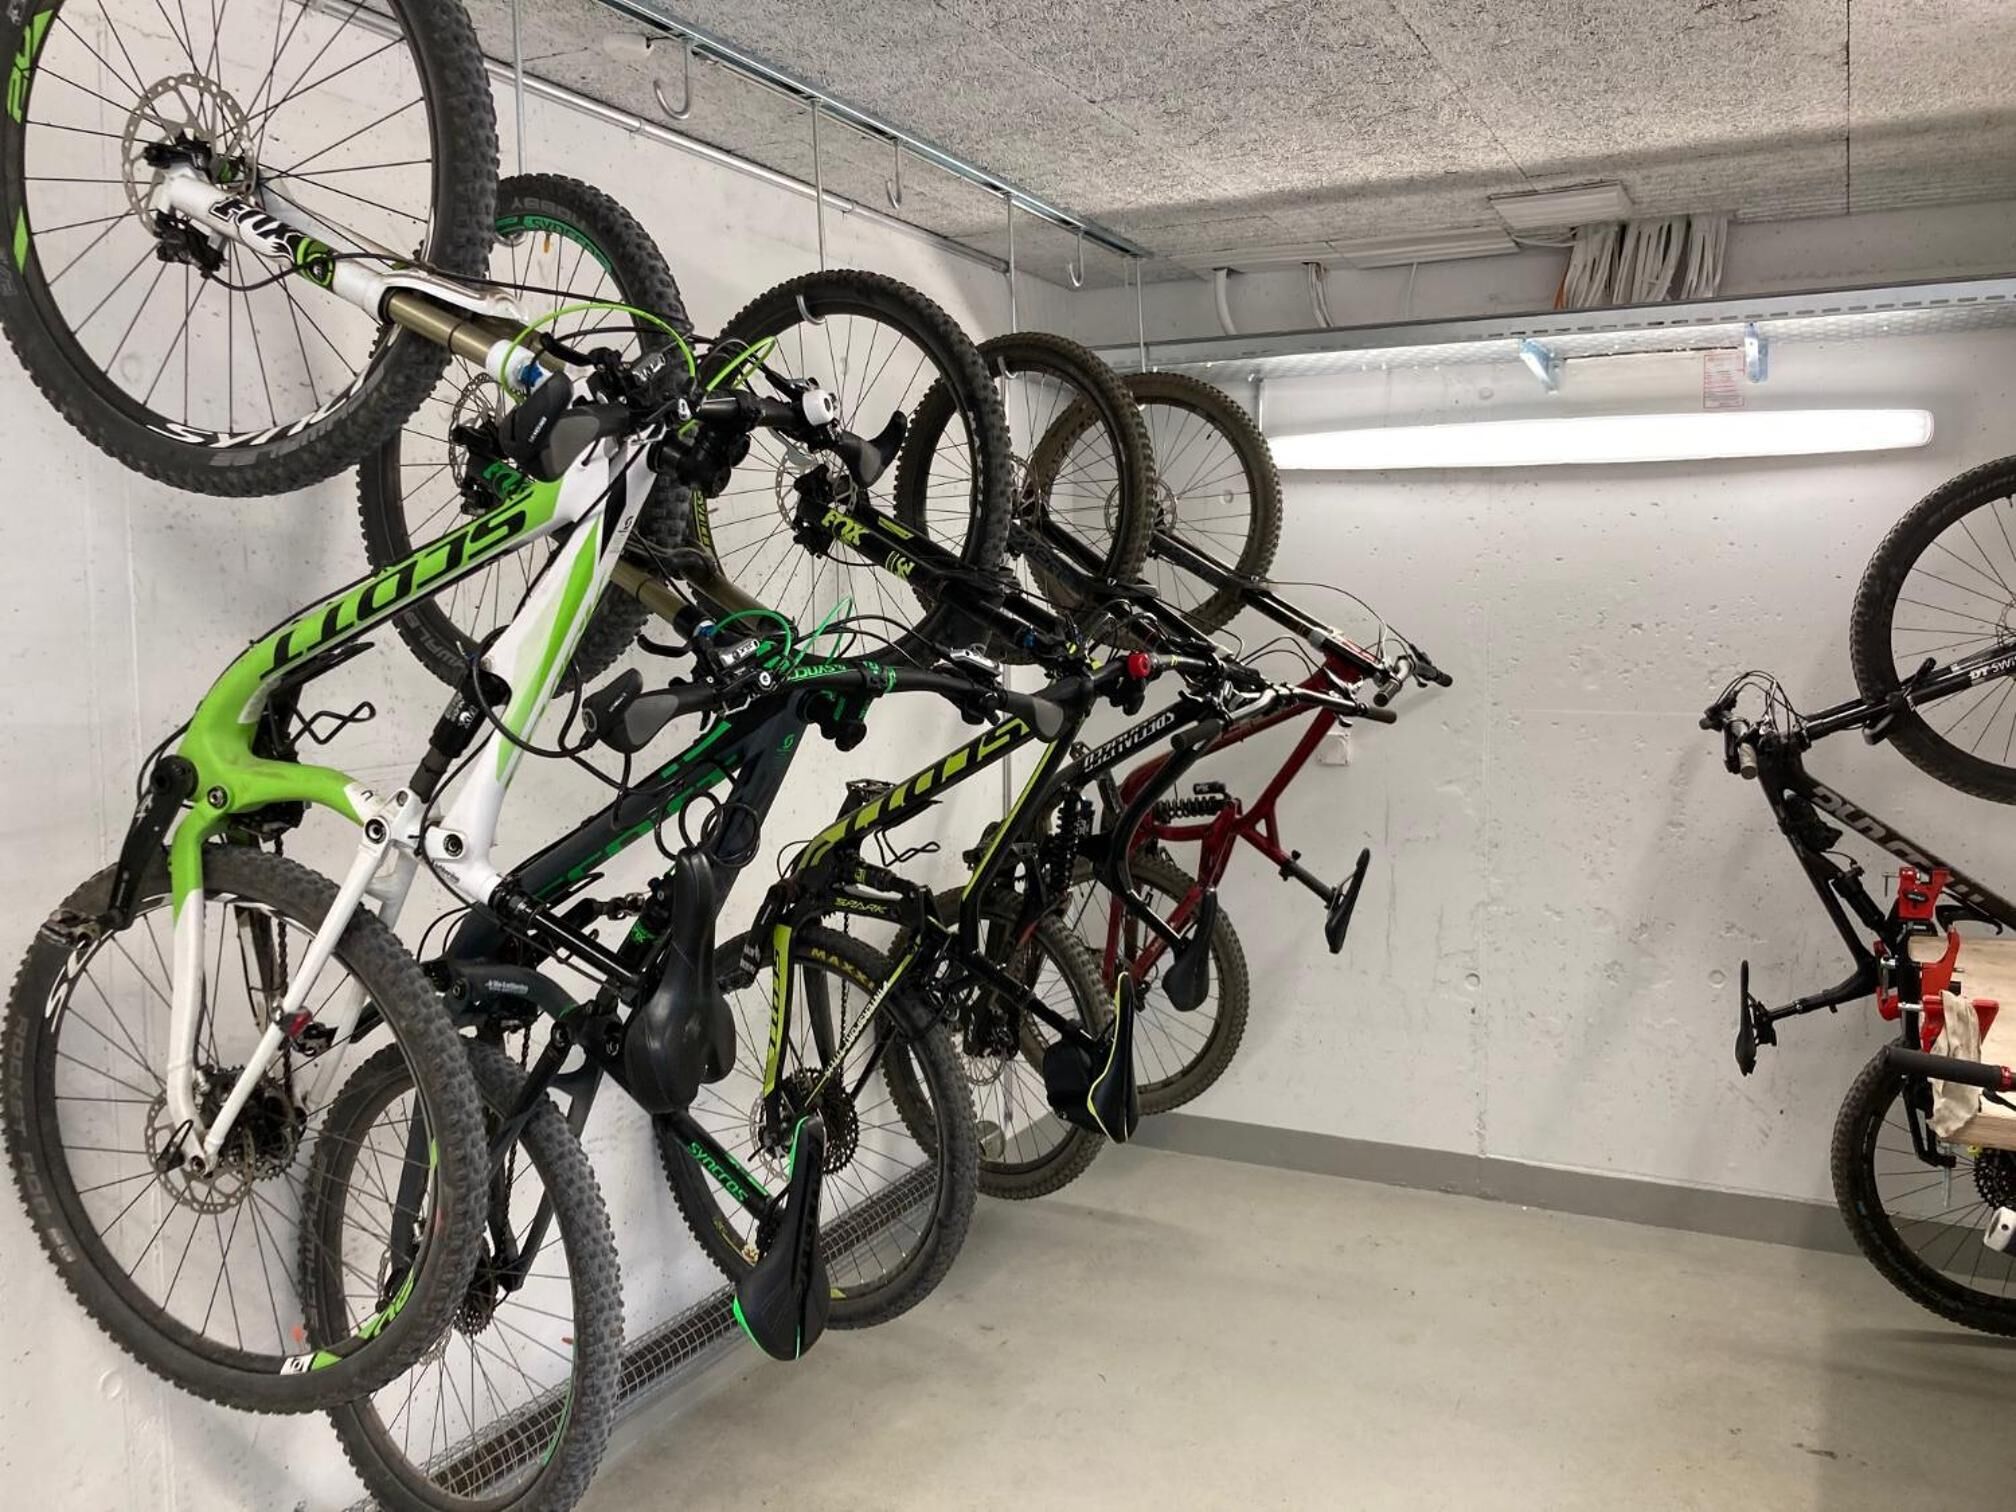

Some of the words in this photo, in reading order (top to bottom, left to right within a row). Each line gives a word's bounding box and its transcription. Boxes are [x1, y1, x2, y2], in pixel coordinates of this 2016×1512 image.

[821, 509, 872, 546] FOX
[260, 490, 534, 680] SCOTT
[1084, 712, 1175, 773] SPECIALIZED
[835, 897, 888, 914] SPARK
